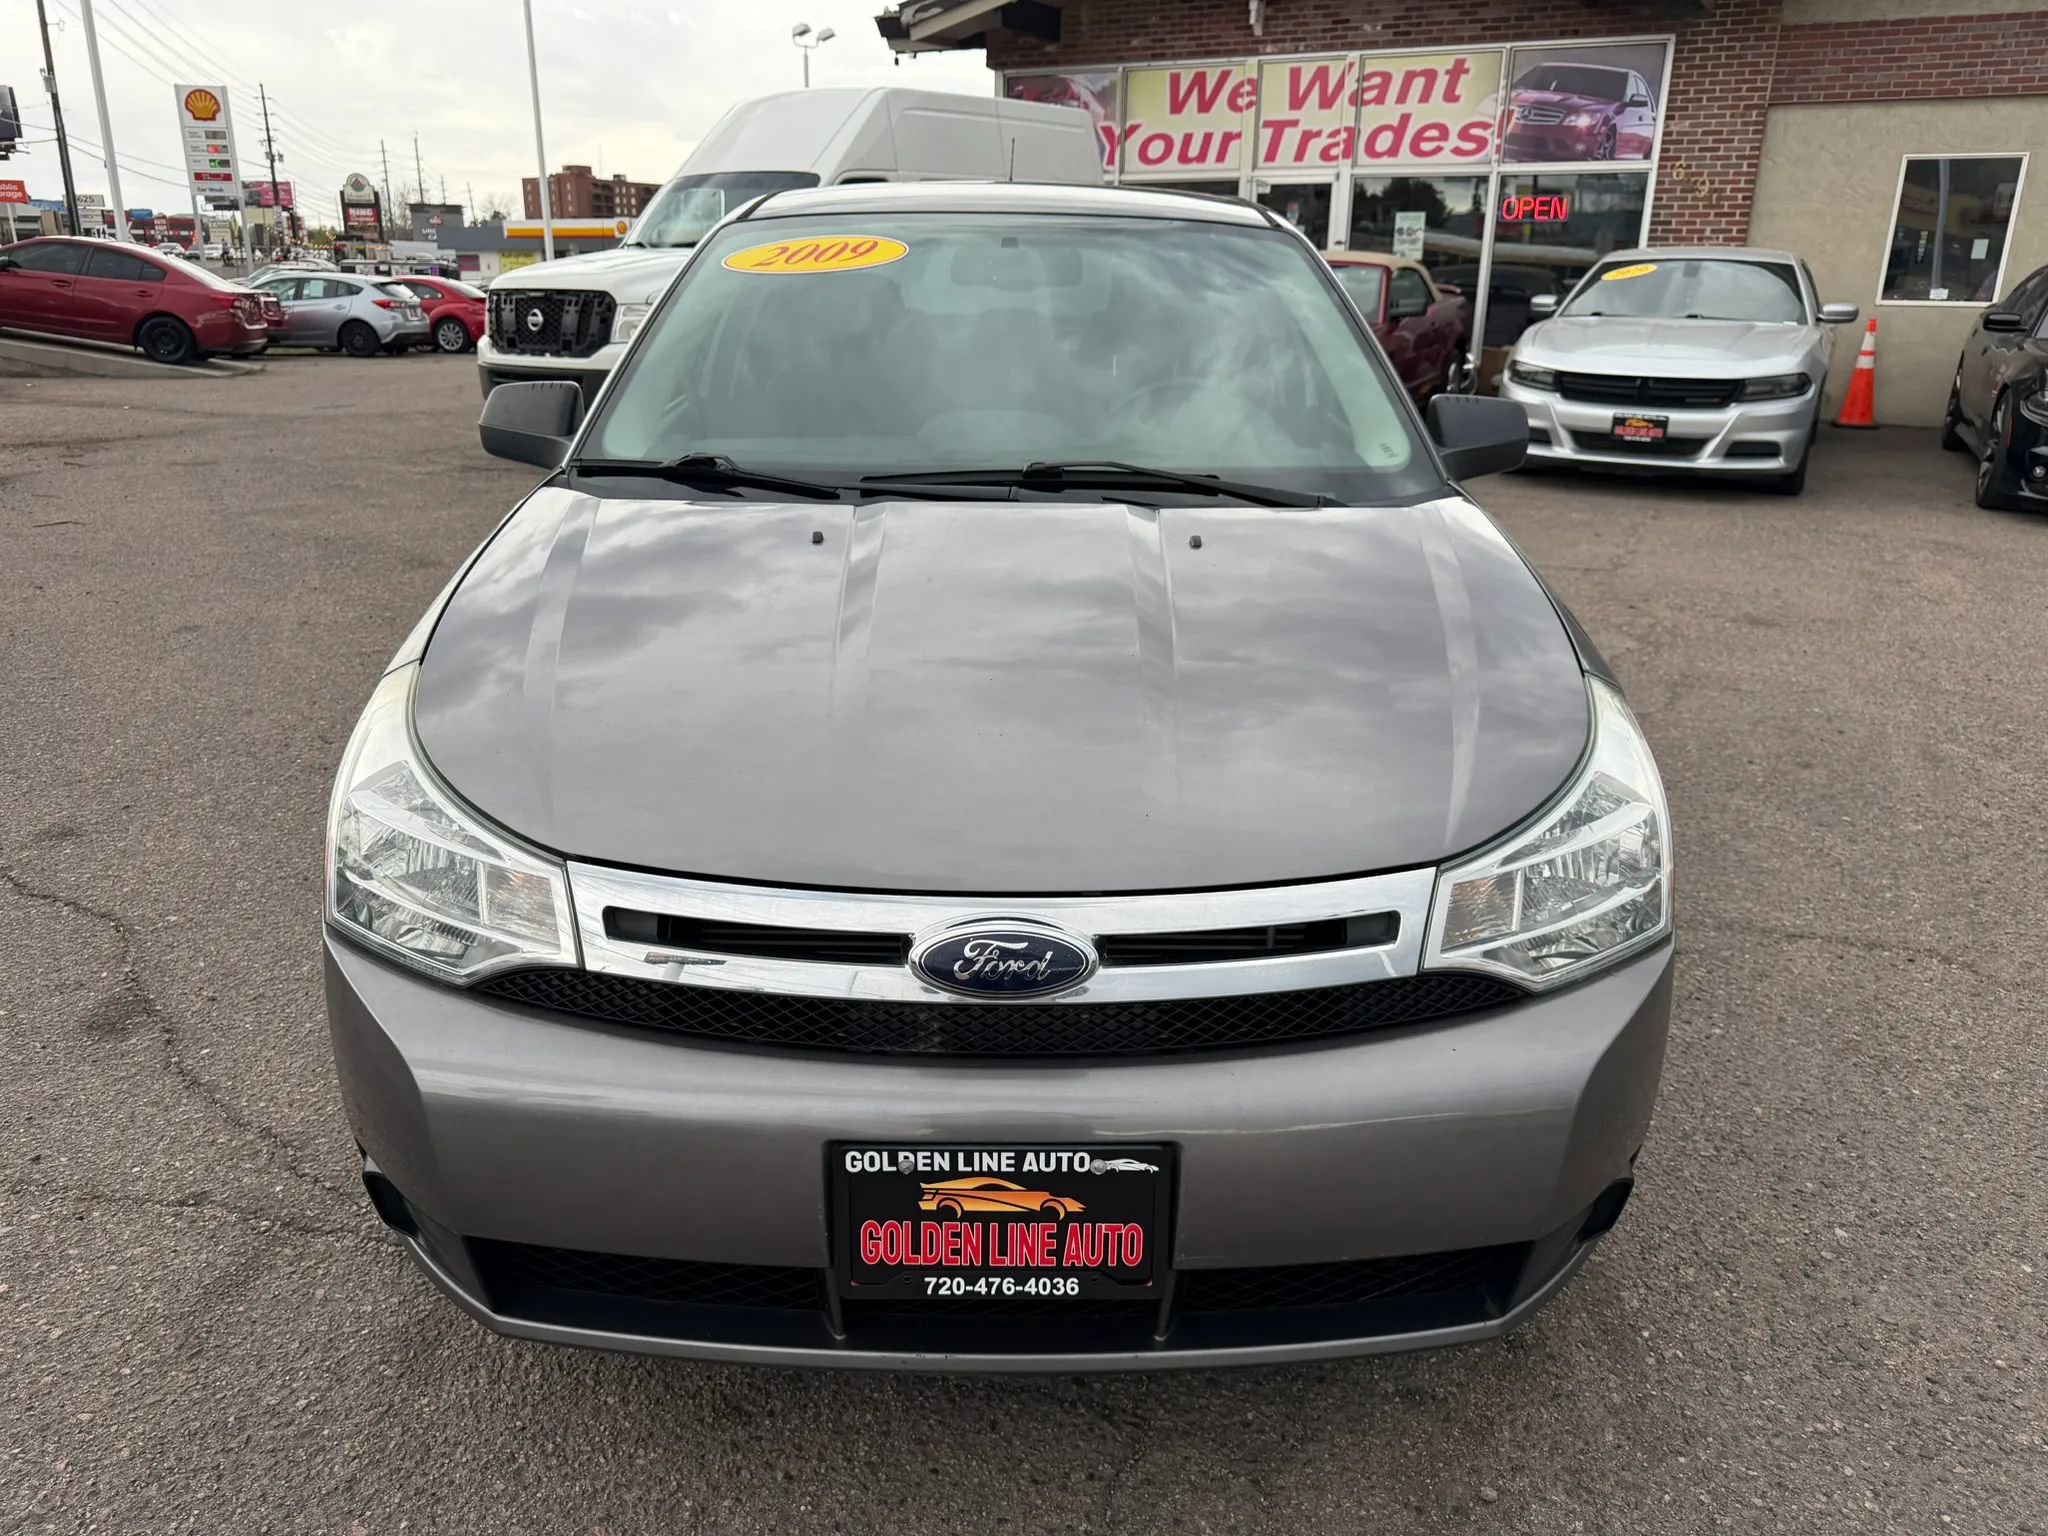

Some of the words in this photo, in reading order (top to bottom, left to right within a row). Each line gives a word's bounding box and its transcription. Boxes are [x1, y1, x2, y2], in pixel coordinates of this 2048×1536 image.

[1169, 69, 1257, 116] We
[1288, 57, 1472, 112] Want
[1099, 122, 1243, 168] Your
[1502, 197, 1569, 222] OPEN
[751, 240, 879, 266] 2009
[953, 938, 1054, 981] Ford
[845, 1151, 950, 1172] GOLDEN
[957, 1151, 1015, 1172] LINE
[1022, 1151, 1091, 1173] AUTO
[860, 1220, 982, 1266] GOLDEN
[989, 1223, 1057, 1267] LINE
[1063, 1223, 1143, 1267] AUTO
[924, 1277, 1080, 1296] 720-476-4036
